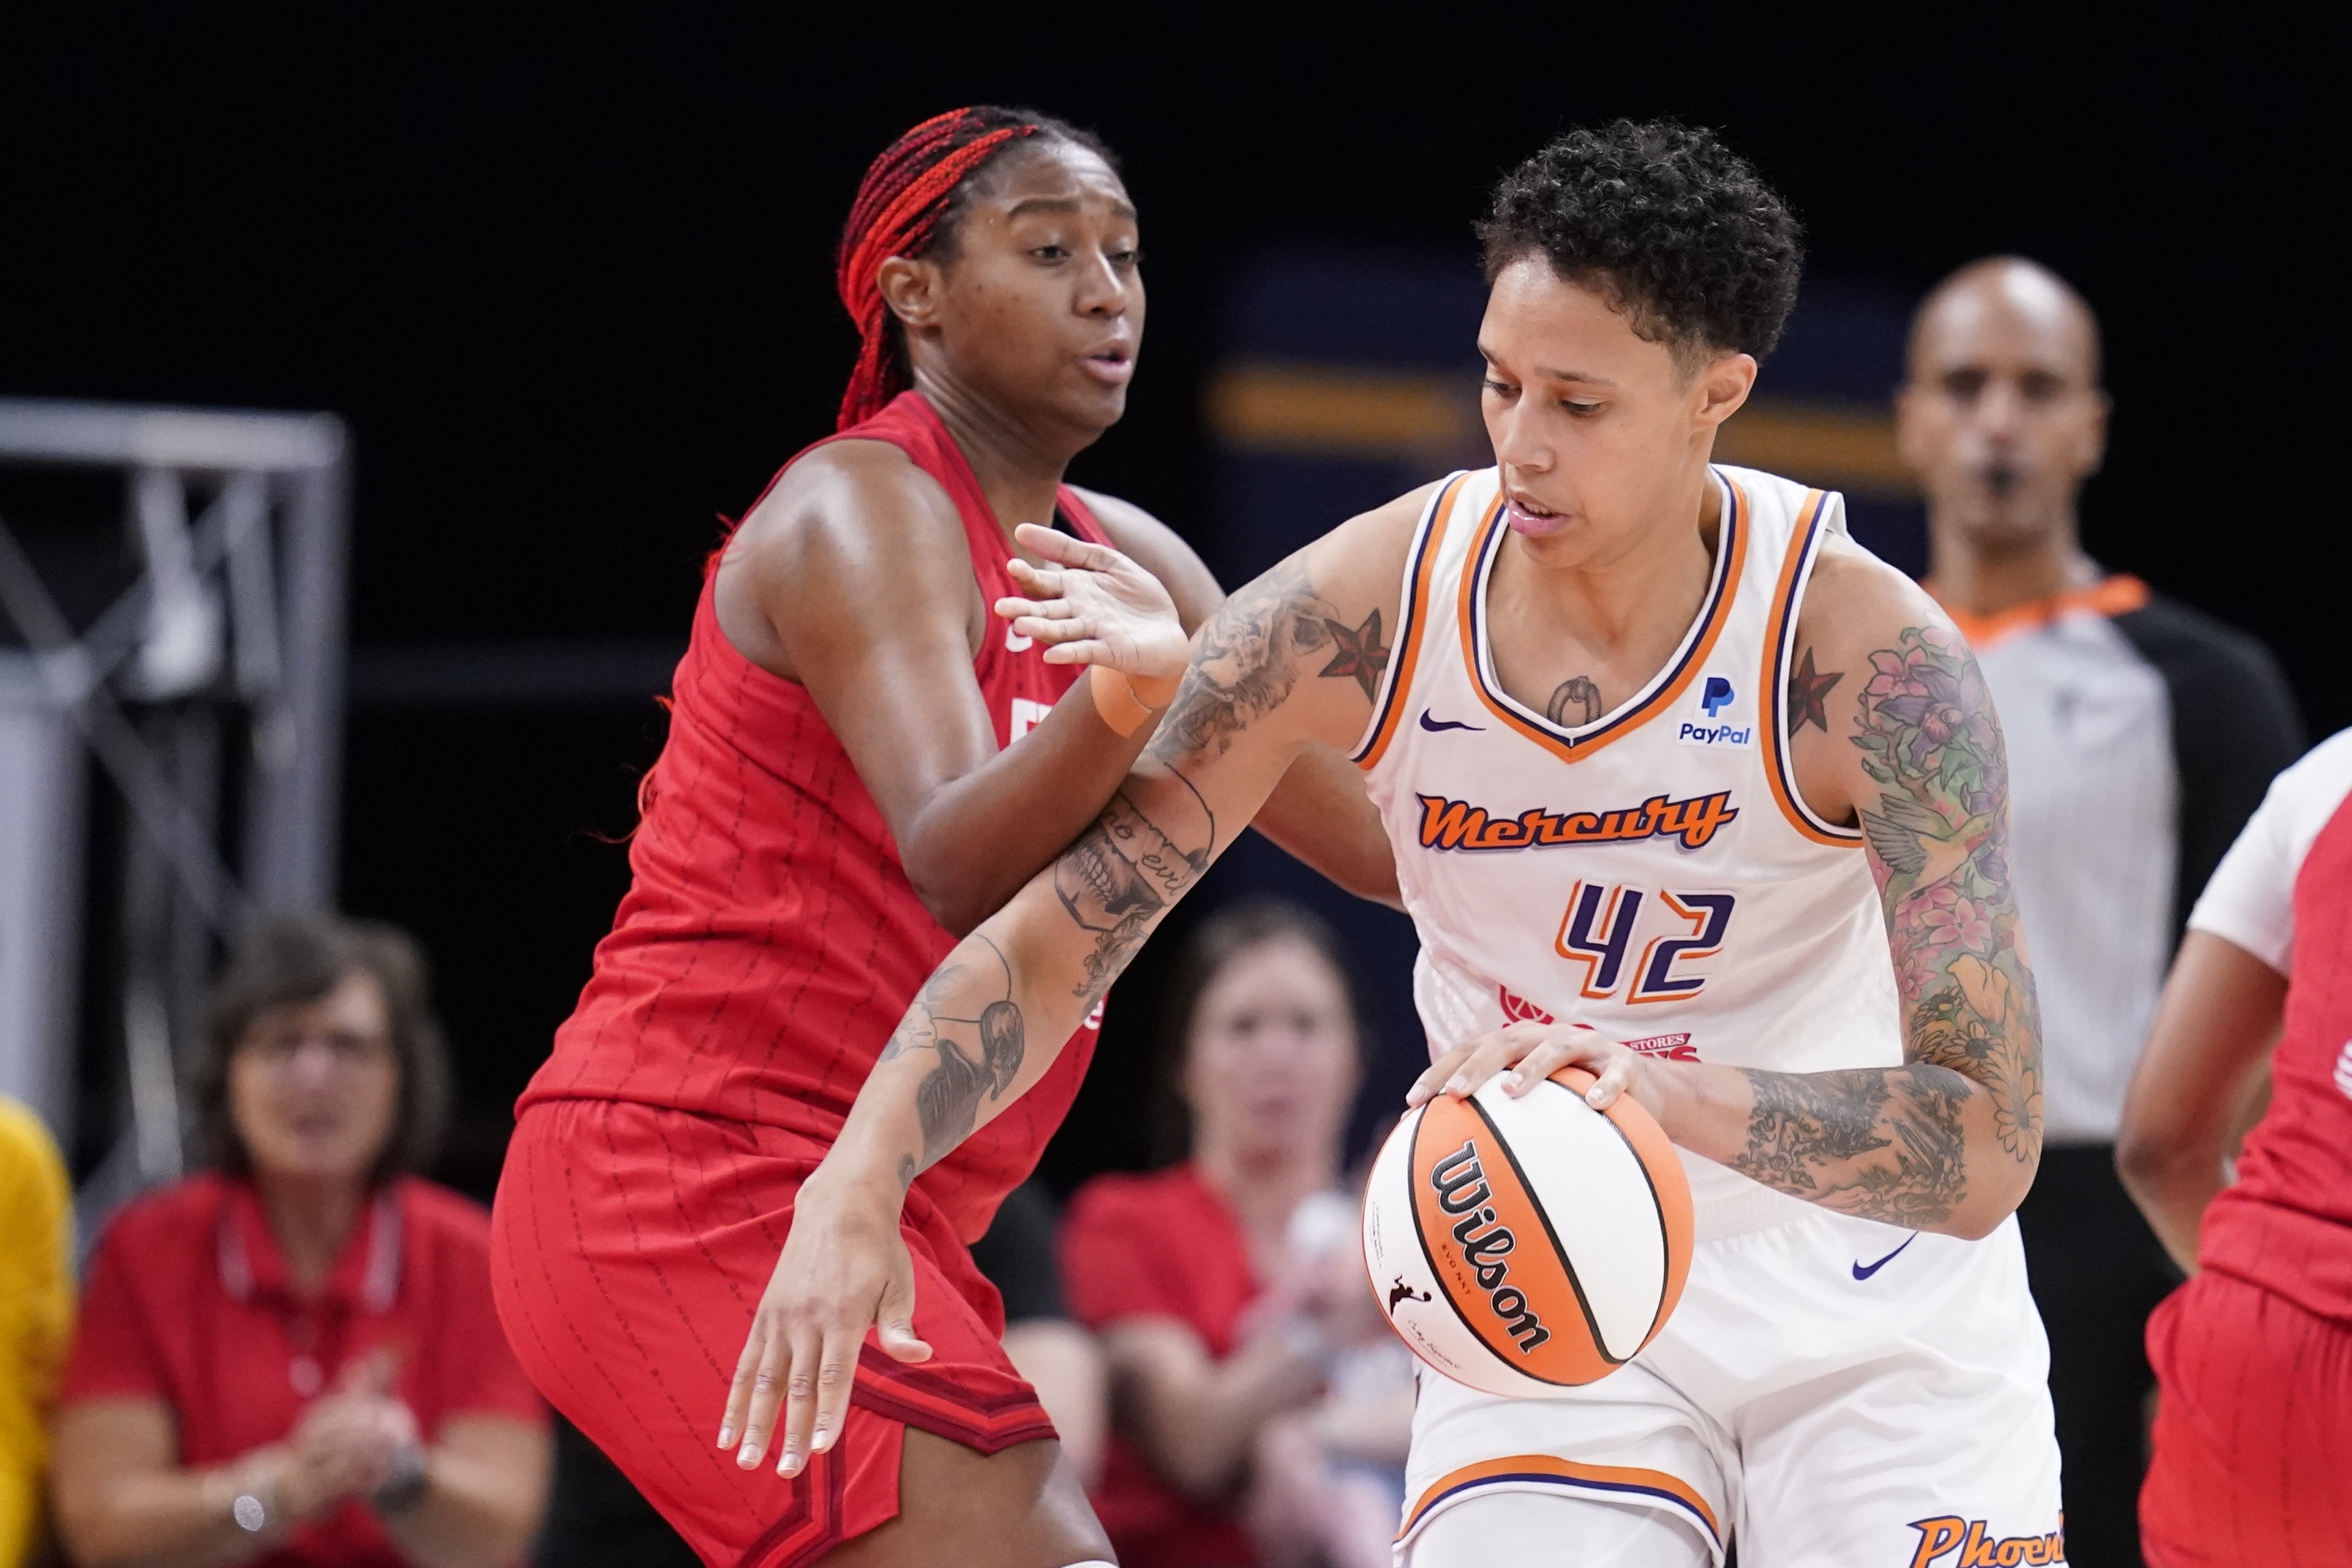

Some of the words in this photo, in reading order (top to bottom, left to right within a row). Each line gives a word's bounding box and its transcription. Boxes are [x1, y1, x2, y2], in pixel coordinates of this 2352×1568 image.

[1680, 724, 1750, 744] PayPal
[1416, 790, 1739, 852] Mercury
[1555, 879, 1738, 1005] 42
[1629, 1034, 1685, 1050] STORES
[1430, 1139, 1551, 1354] Wilson
